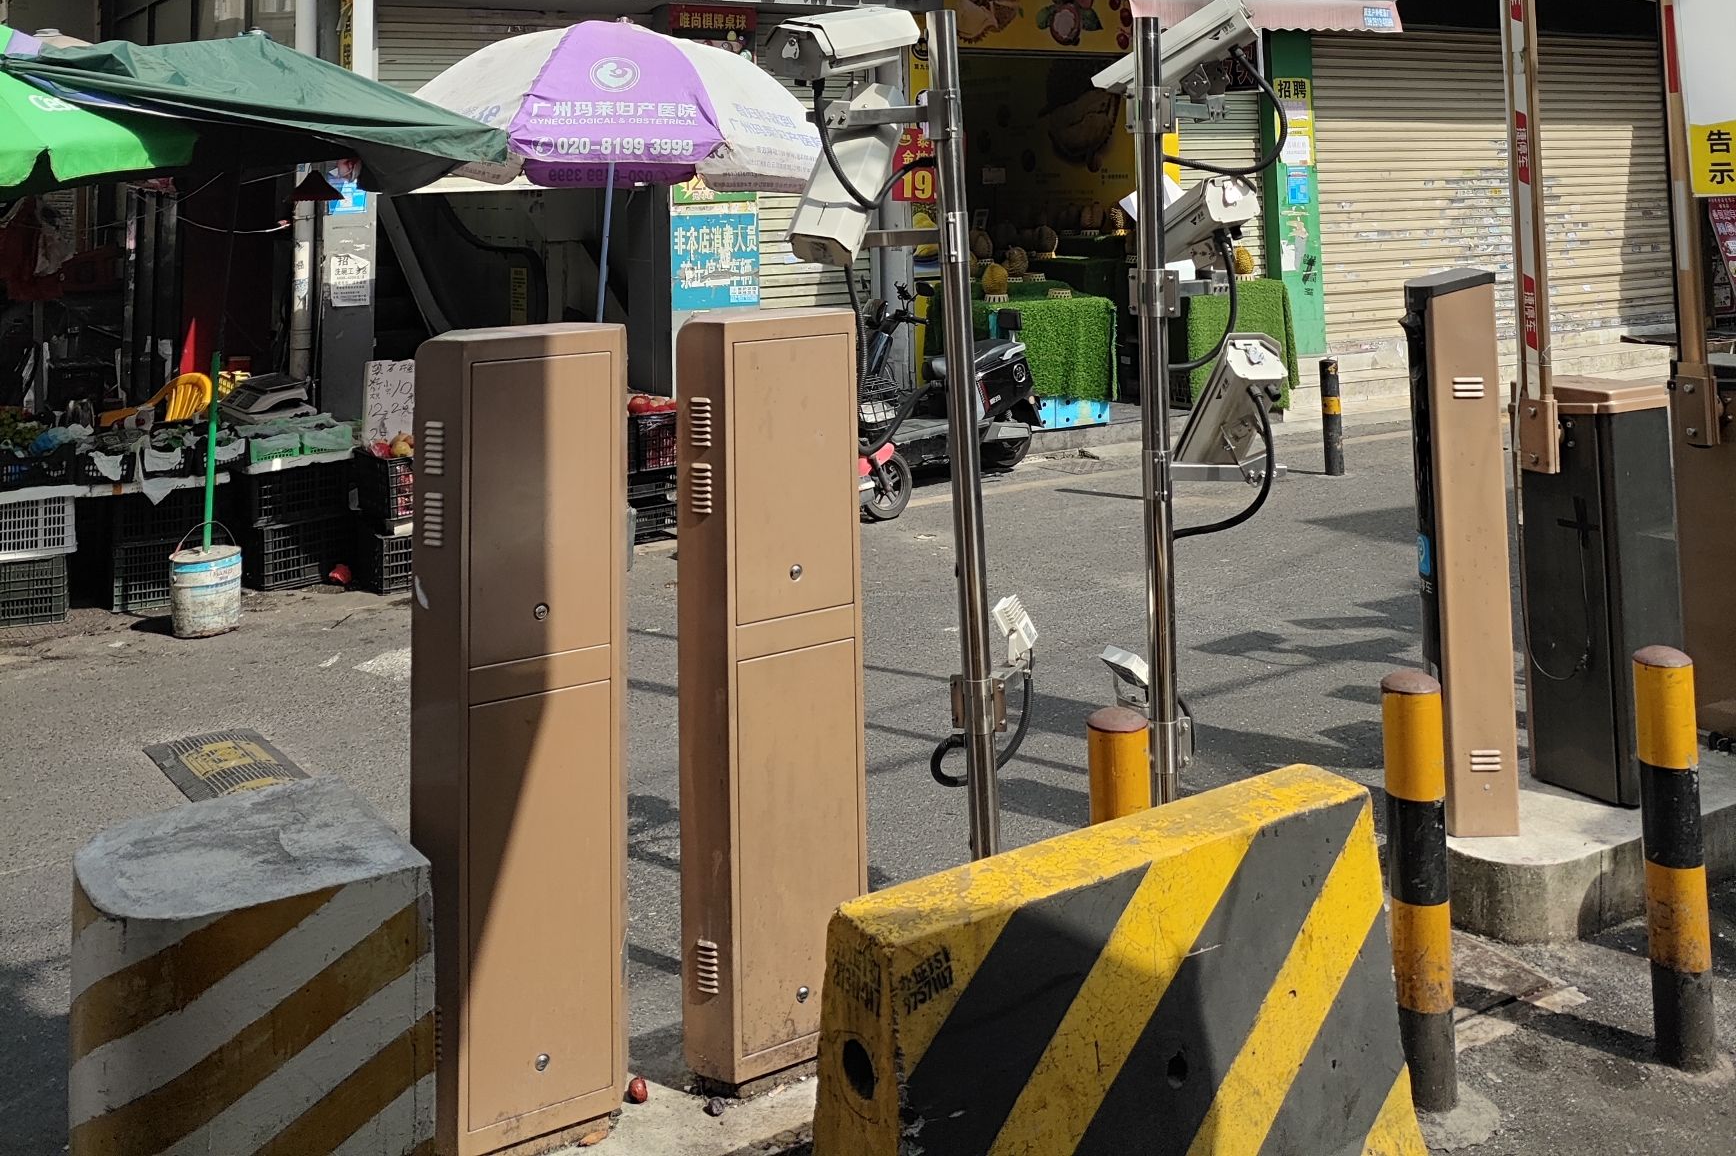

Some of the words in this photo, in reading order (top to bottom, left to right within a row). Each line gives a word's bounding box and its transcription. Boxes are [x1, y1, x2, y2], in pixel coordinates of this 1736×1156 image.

[679, 11, 747, 30] 唯尚棋牌桌球
[1277, 79, 1306, 98] 招聘
[532, 101, 697, 118] 广州玛莱妇产医院
[556, 137, 645, 155] 020-8199
[650, 138, 693, 155] 3999
[1706, 130, 1736, 185] 告示
